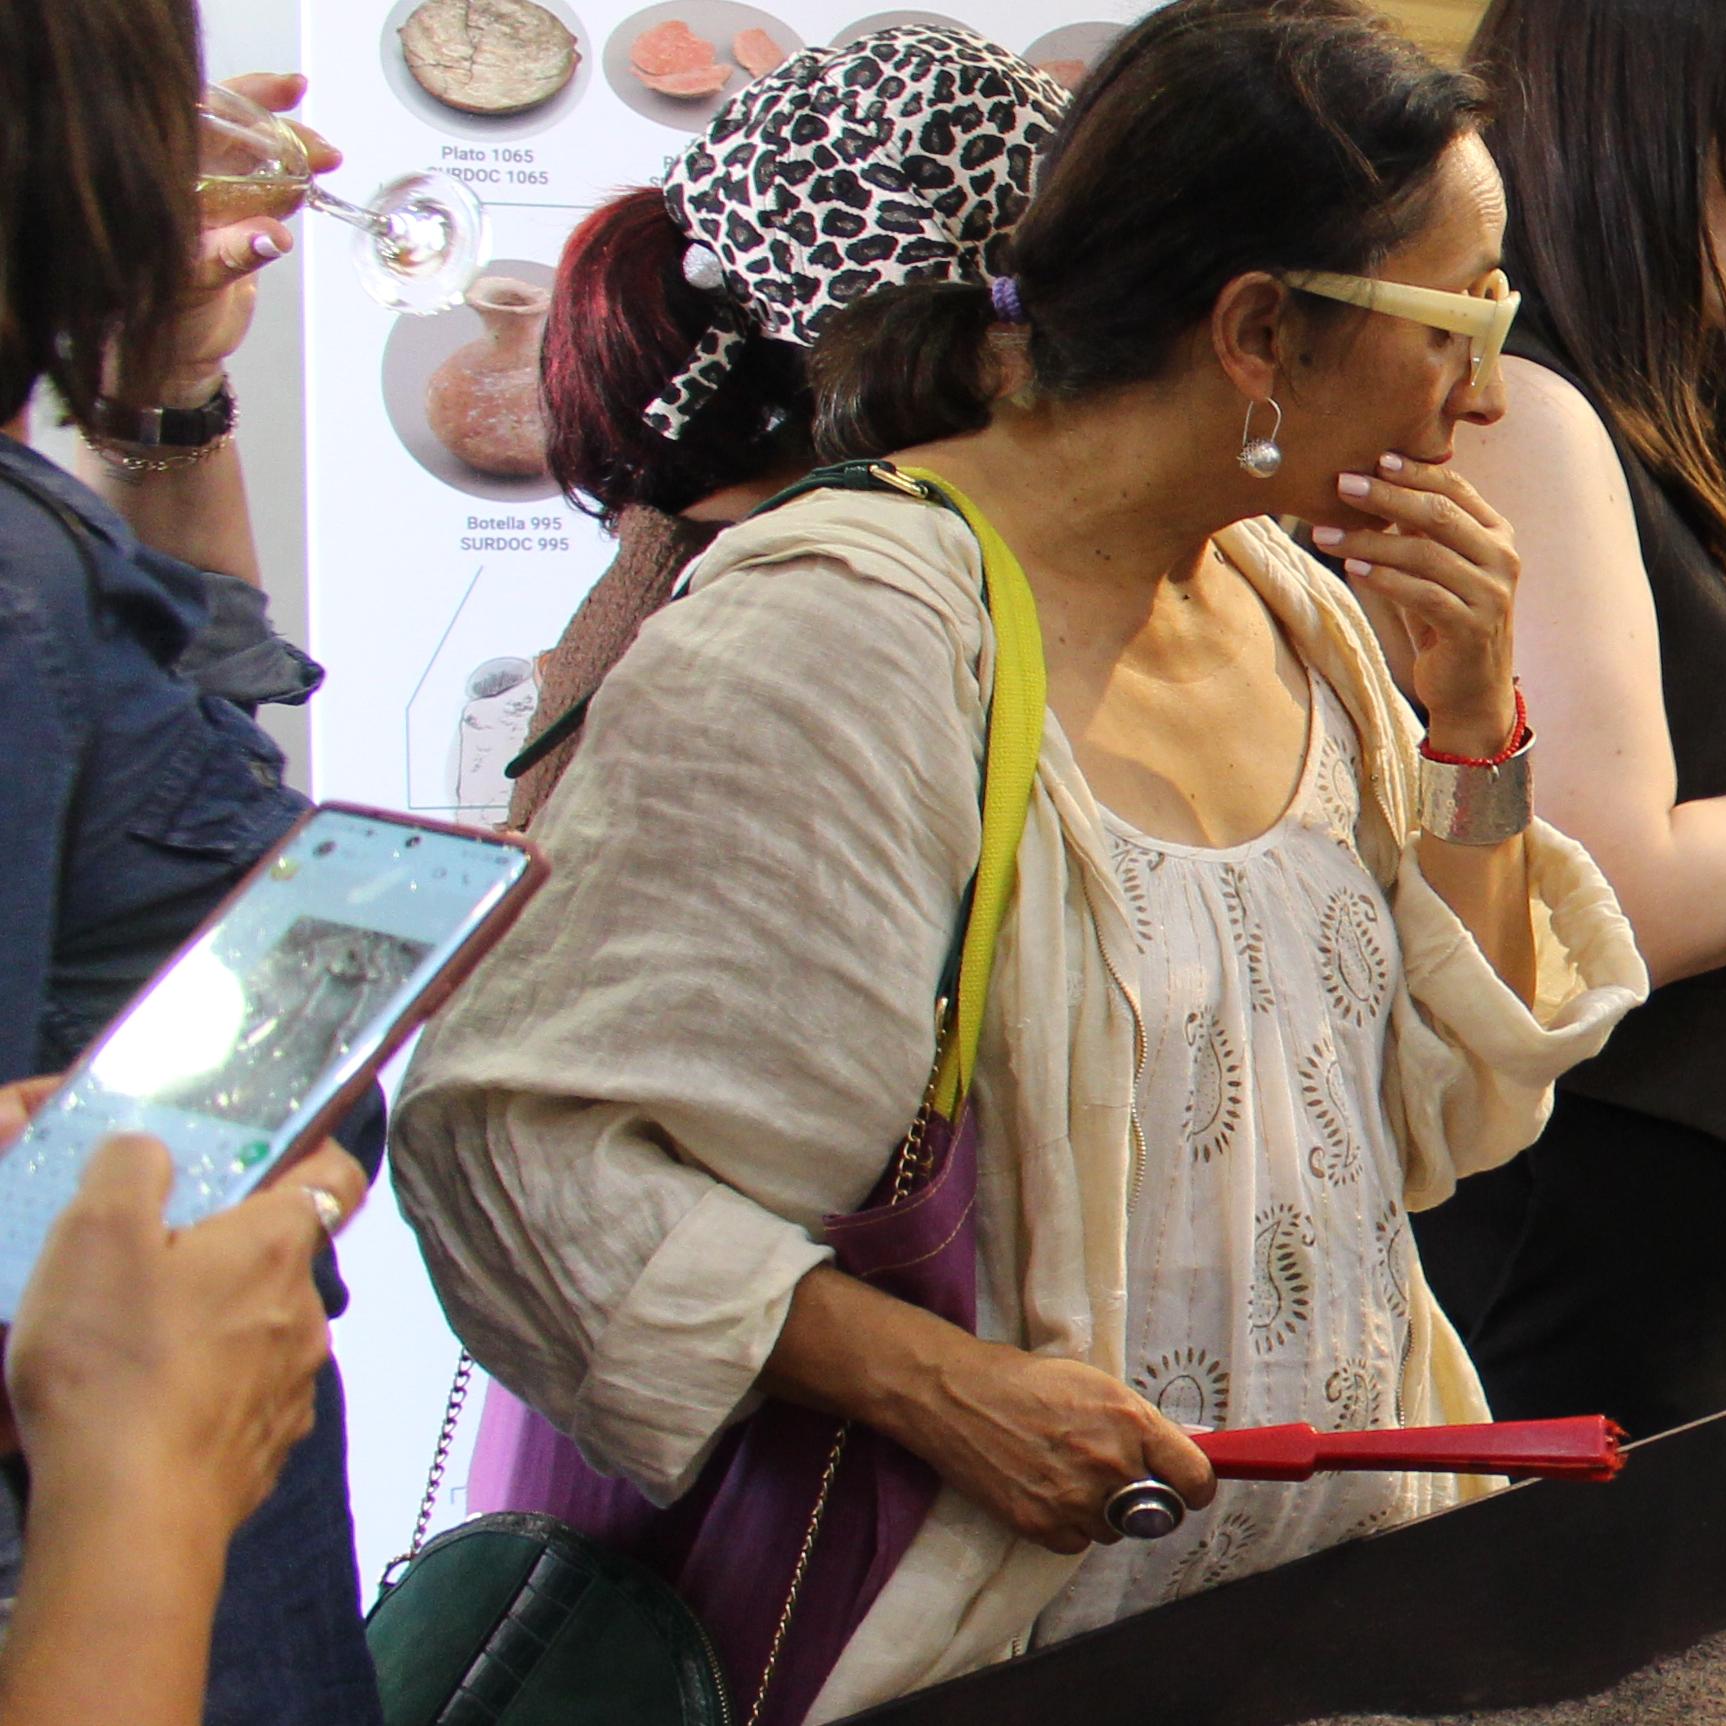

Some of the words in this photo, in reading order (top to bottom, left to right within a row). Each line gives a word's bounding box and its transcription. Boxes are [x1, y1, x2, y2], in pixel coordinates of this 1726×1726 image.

[441, 145, 487, 161] Plato
[491, 147, 535, 164] 1065
[428, 166, 501, 183] RDOC
[506, 169, 549, 185] 1065
[466, 515, 526, 531] Botella
[530, 516, 563, 531] 995
[459, 536, 534, 552] SURDOC
[537, 537, 570, 552] 995
